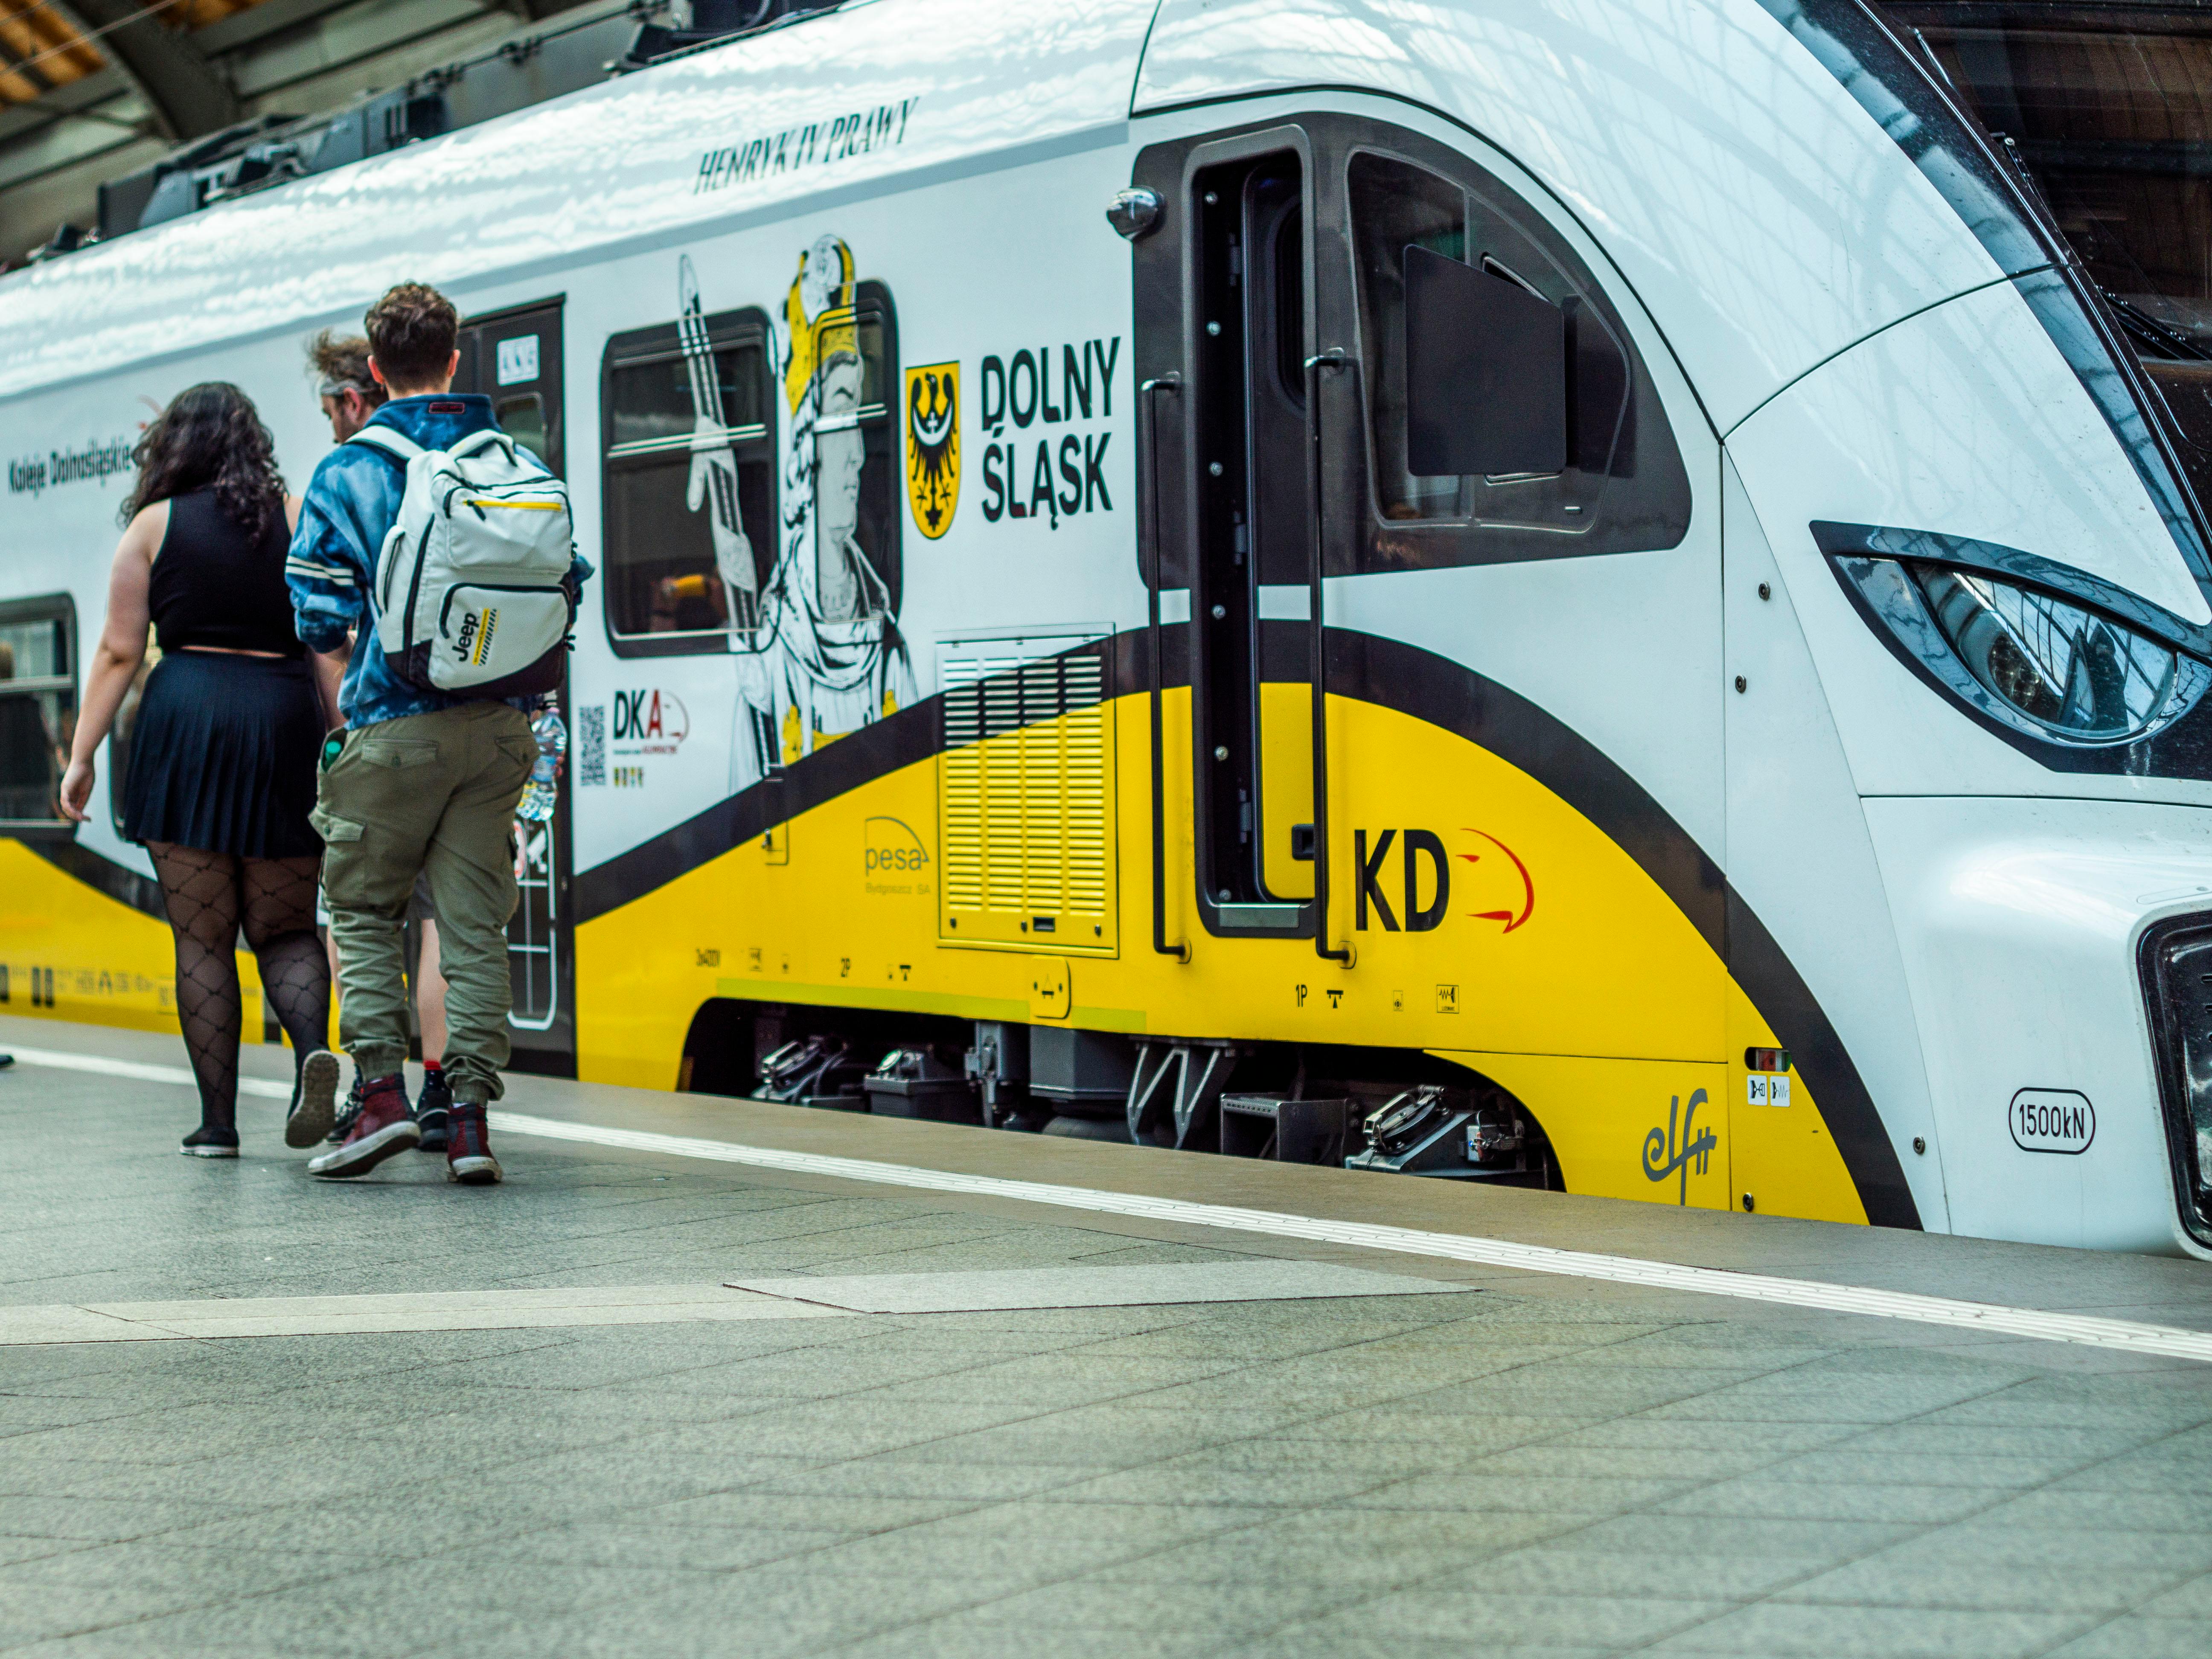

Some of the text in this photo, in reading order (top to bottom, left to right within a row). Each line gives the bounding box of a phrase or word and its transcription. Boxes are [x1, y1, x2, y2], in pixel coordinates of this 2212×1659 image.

[693, 96, 920, 195] HENRYK IV PRAWY
[981, 336, 1121, 431] DOLNY
[8, 451, 46, 499] Koleje
[981, 425, 1113, 531] ŚLĄSK
[452, 612, 480, 662] Jeep
[613, 689, 662, 739] DKA
[865, 848, 922, 876] pesa
[1354, 829, 1451, 933] KD
[1295, 984, 1308, 1007] 1P
[2019, 1103, 2085, 1140] 1500kN
